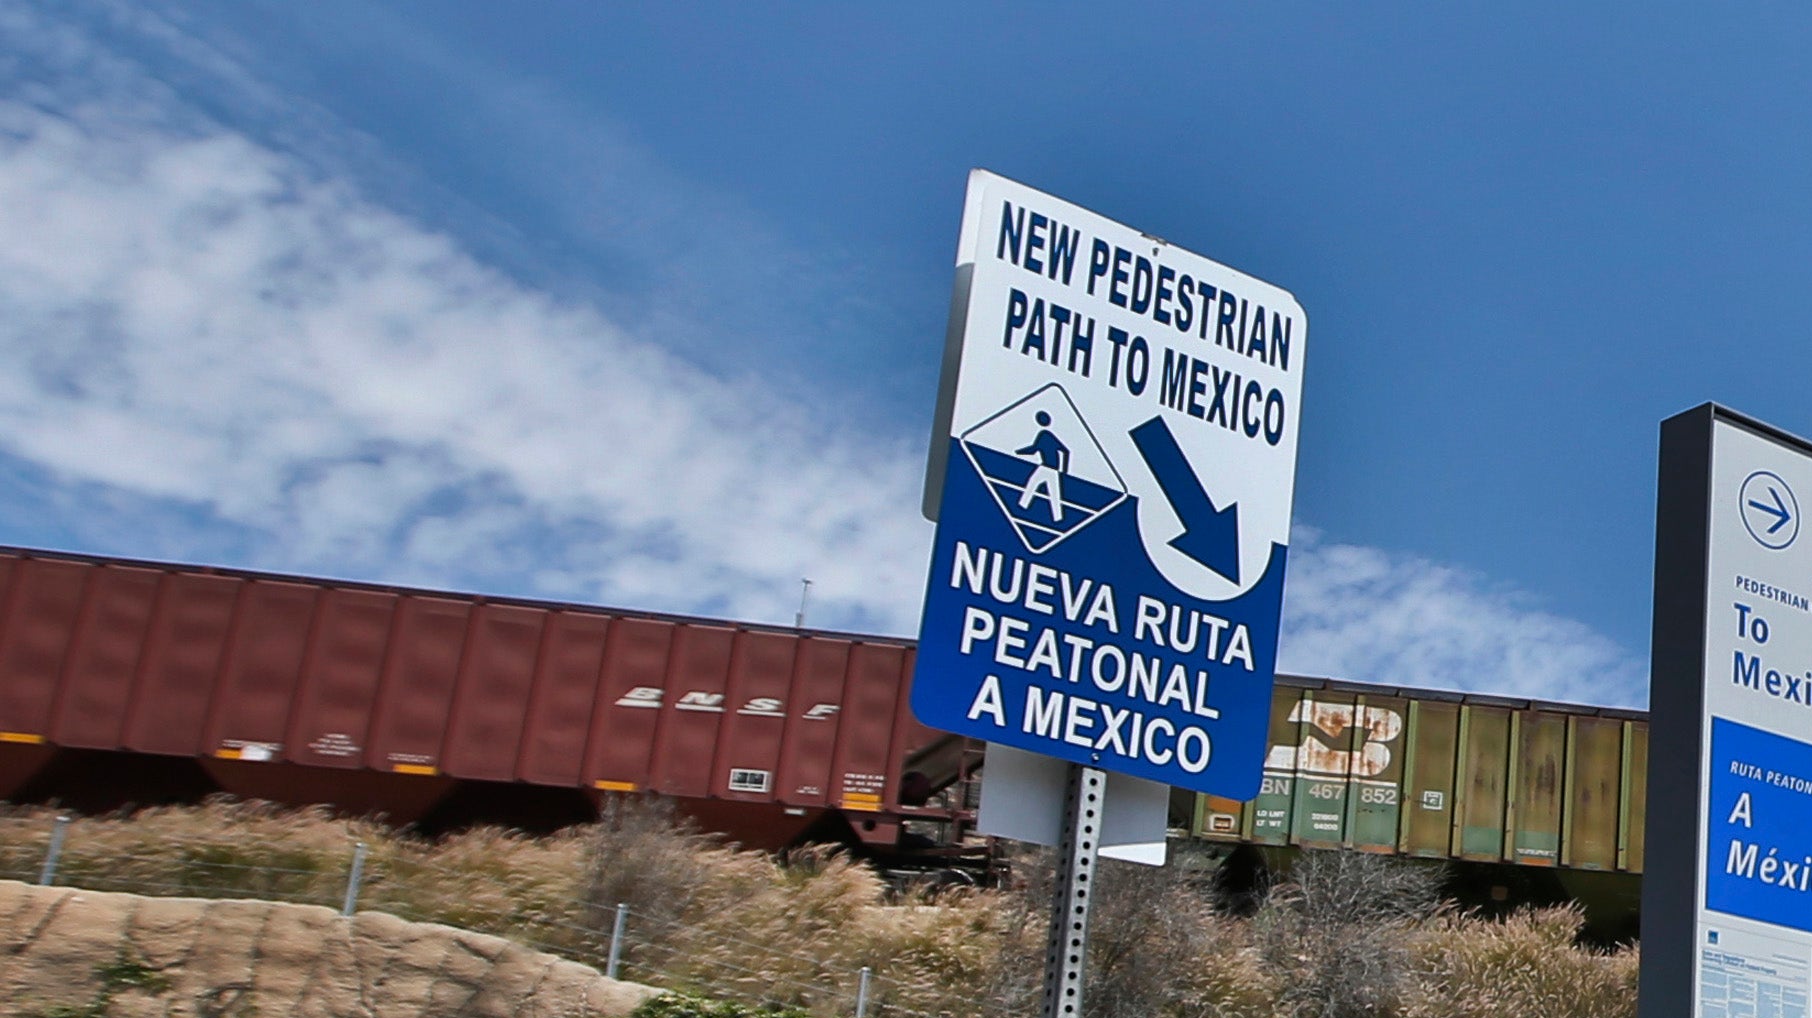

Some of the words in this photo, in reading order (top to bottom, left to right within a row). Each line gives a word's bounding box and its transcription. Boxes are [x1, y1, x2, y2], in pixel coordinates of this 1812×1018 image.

[996, 200, 1081, 286] NEW
[1087, 236, 1292, 372] PEDESTRIAN
[1002, 287, 1096, 377] PATH
[1107, 327, 1147, 397] TO
[1159, 348, 1286, 447] MEXICO
[950, 541, 1120, 633] NUEVA
[1135, 595, 1256, 672] RUTA
[1733, 602, 1769, 644] To
[1736, 575, 1809, 611] PEDESTRIAN
[959, 608, 1221, 721] PEATONAL
[966, 675, 1007, 727] A
[1022, 686, 1212, 774] MEXICO
[1308, 783, 1345, 800] 467
[1361, 788, 1397, 805] 852
[1730, 761, 1763, 781] RUTA
[1728, 792, 1752, 828] A
